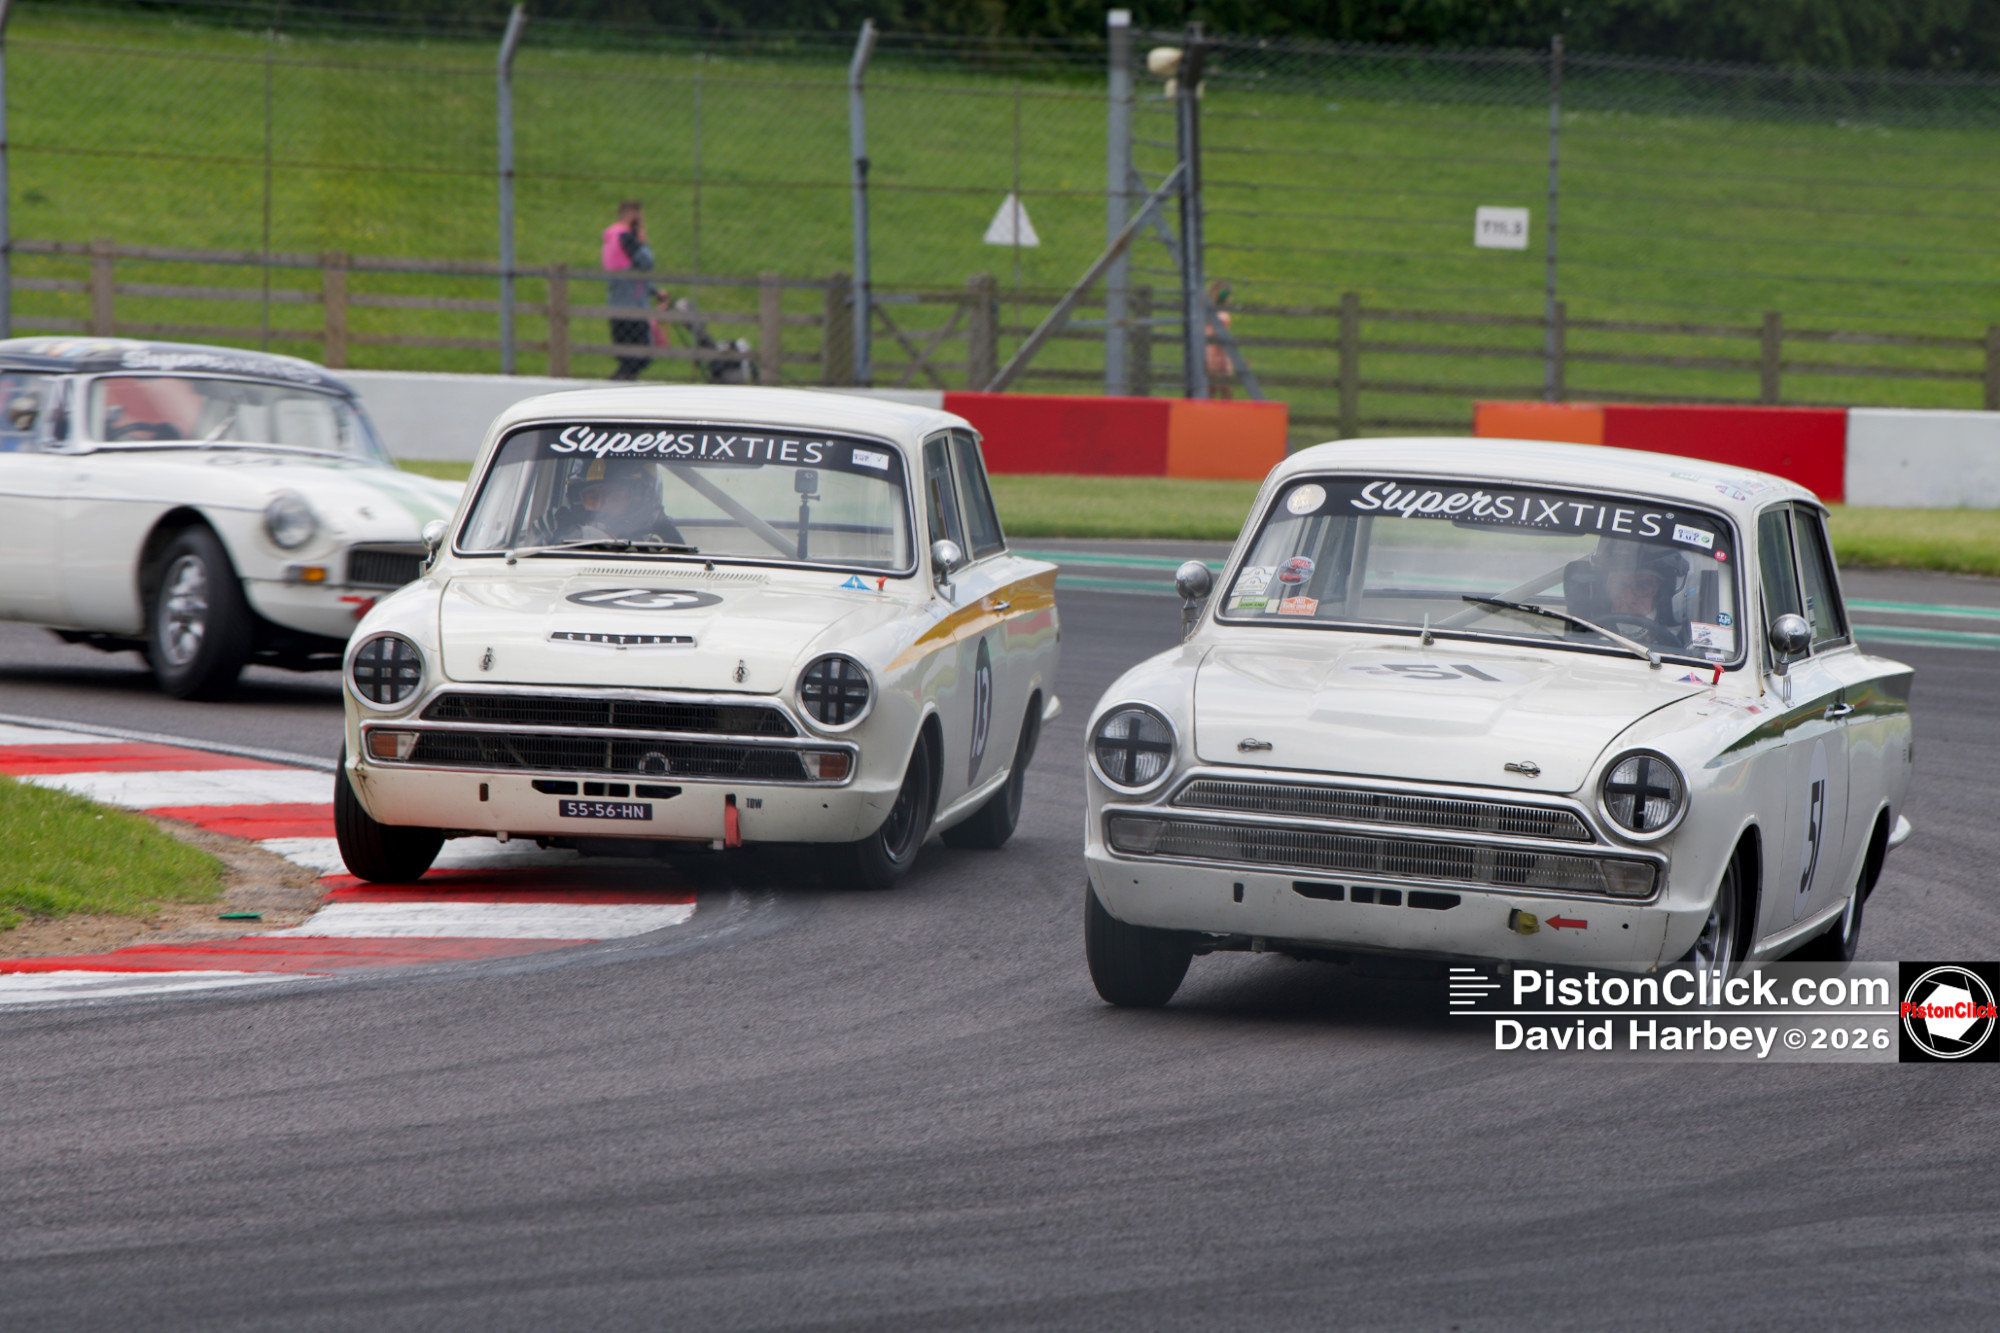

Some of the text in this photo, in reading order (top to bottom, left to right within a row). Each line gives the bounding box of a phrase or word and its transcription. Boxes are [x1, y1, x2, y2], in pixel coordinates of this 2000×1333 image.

[578, 589, 699, 608] 13
[567, 633, 677, 644] CORTINA
[1381, 663, 1503, 683] 51
[970, 666, 990, 758] 13
[566, 802, 646, 818] 55-56-HN
[746, 797, 763, 809] TOW
[1799, 779, 1825, 894] 51
